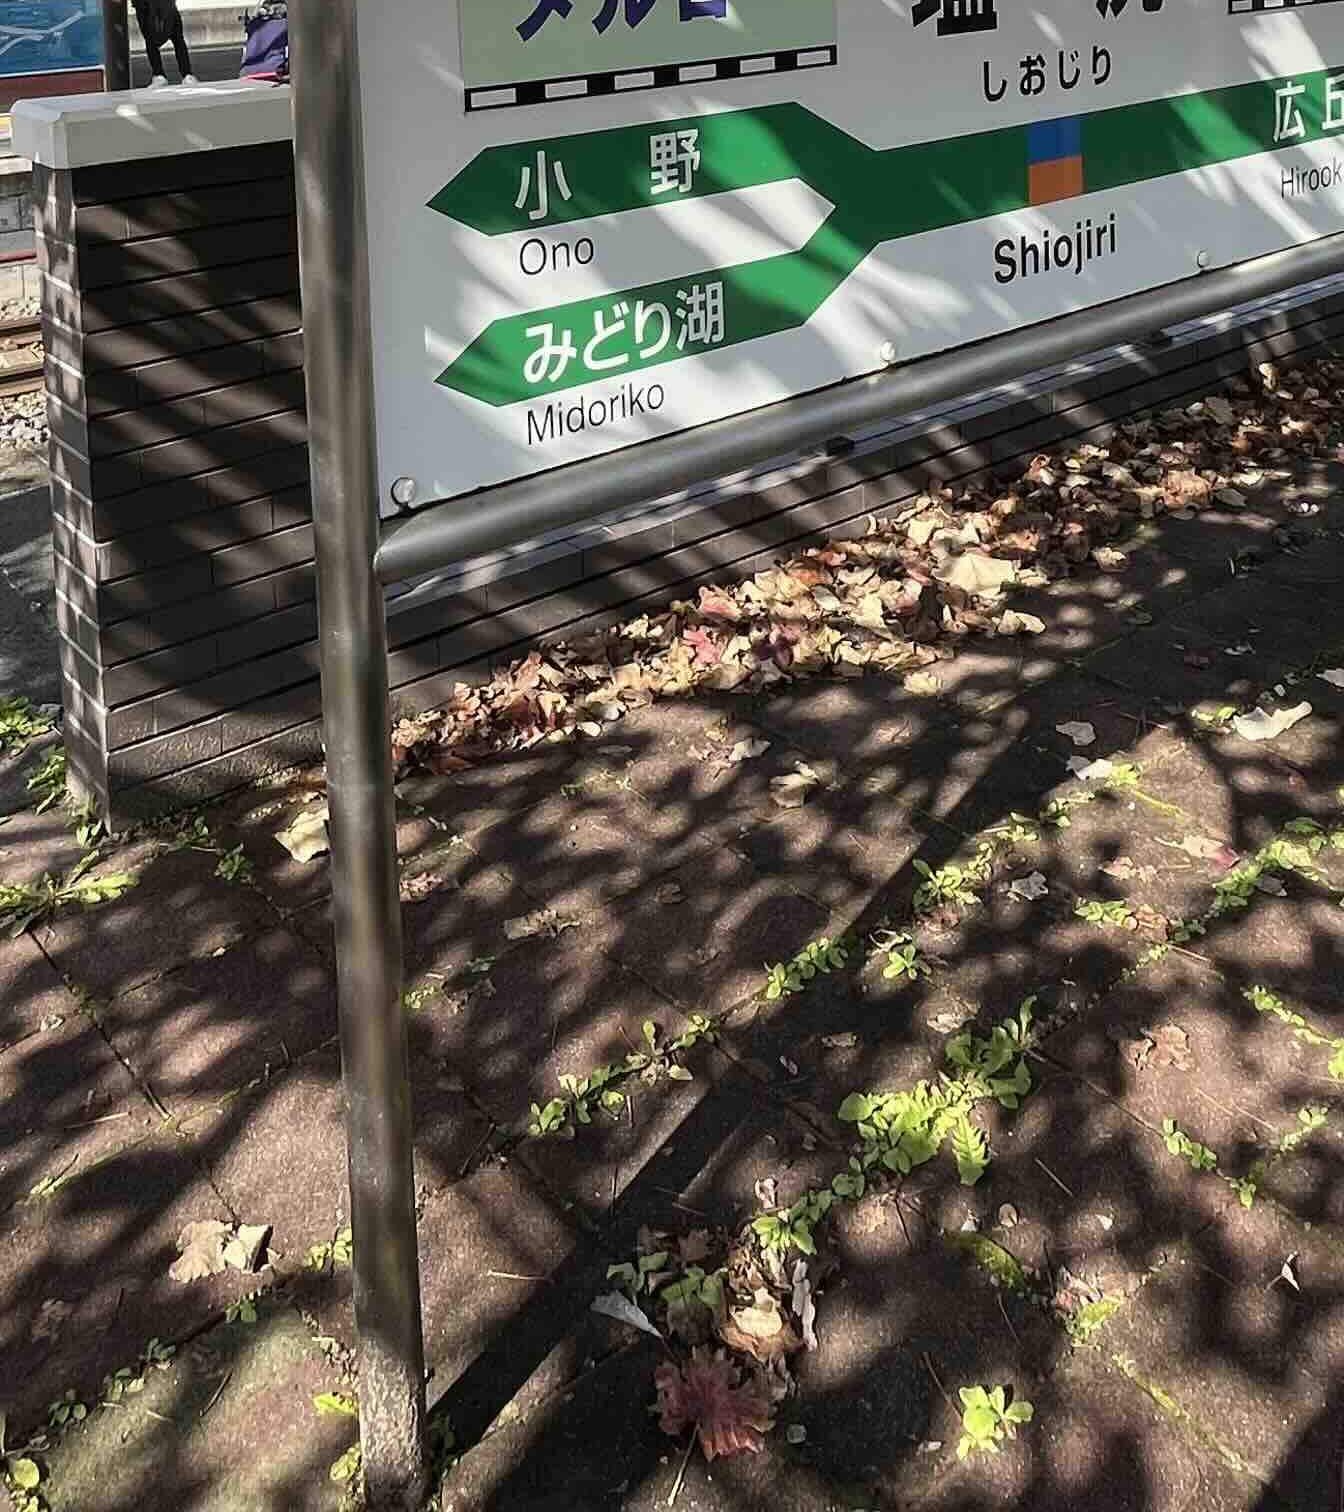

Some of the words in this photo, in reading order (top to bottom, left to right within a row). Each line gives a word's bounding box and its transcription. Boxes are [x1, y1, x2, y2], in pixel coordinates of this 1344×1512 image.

[982, 44, 1112, 103] しおじり
[514, 128, 701, 221] 小野
[518, 236, 595, 276] Ono
[992, 213, 1117, 285] Shiojiri
[521, 281, 725, 384] みどり湖
[526, 383, 665, 446] Midoriko
